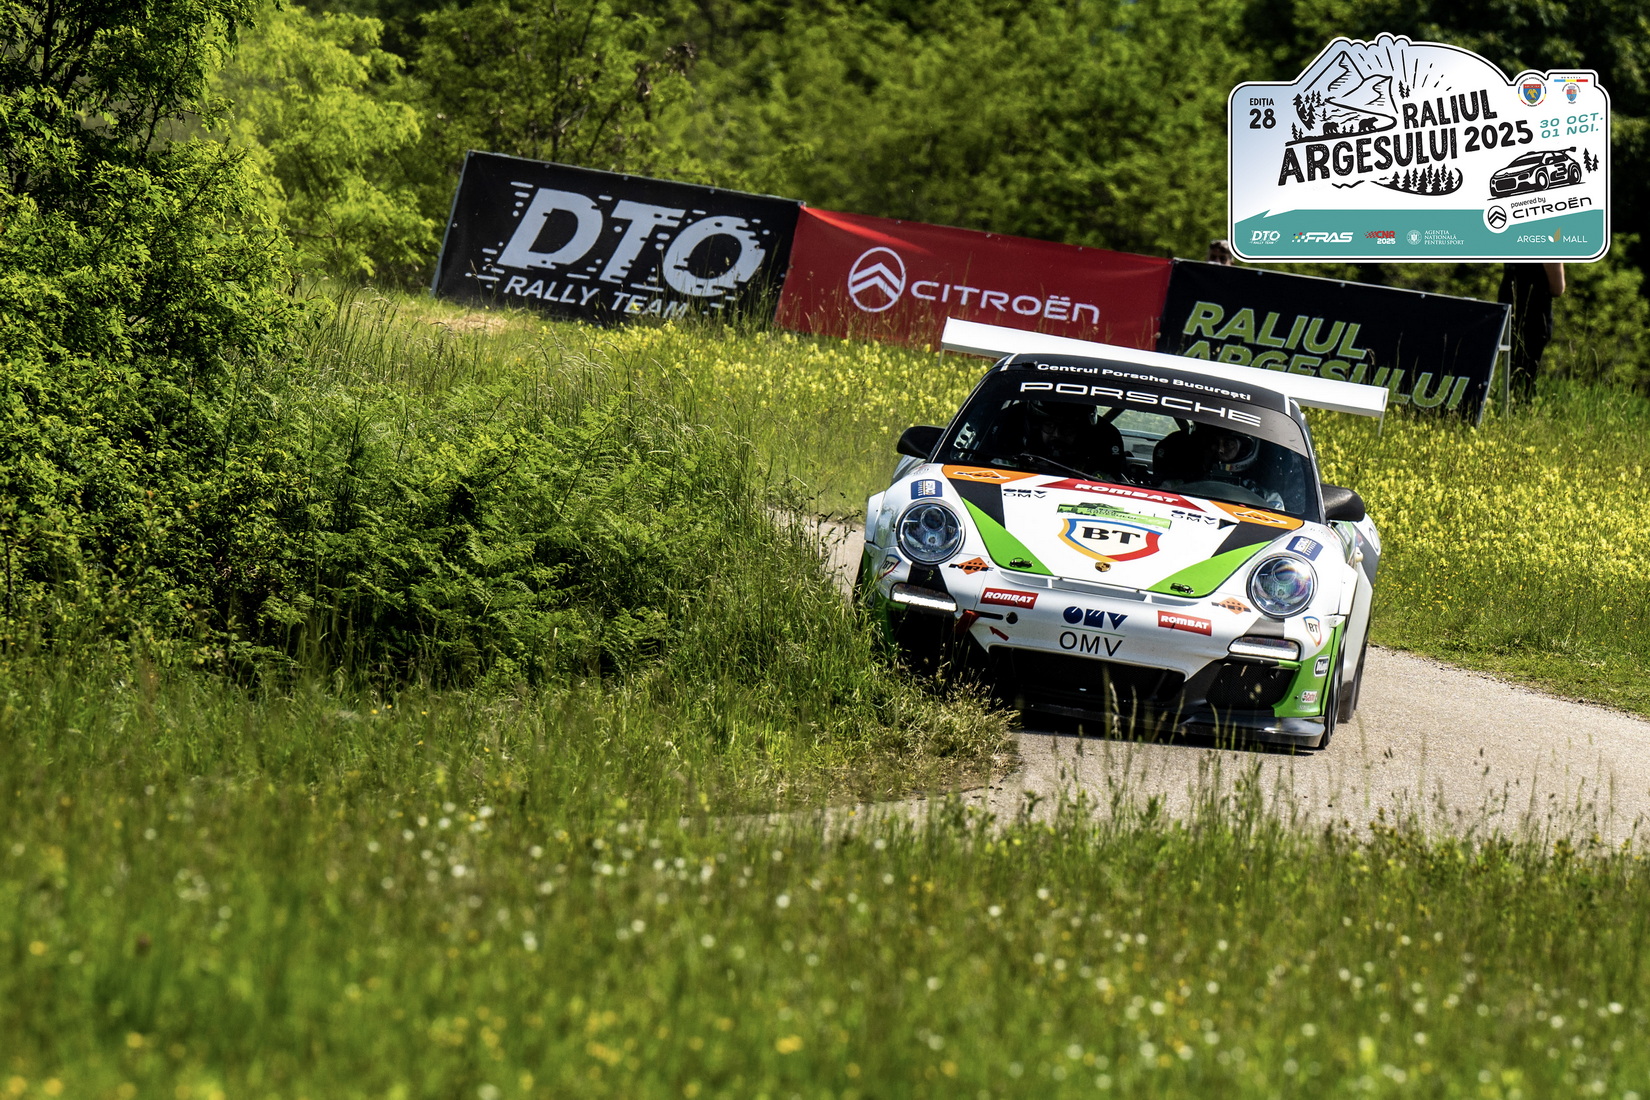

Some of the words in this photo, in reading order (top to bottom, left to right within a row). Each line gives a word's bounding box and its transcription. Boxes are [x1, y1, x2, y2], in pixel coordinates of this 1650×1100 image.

[497, 187, 766, 298] DTO
[504, 275, 599, 306] RALLY
[611, 291, 690, 318] TEAM
[1183, 301, 1367, 360] RALIUL
[1037, 363, 1098, 374] Centrul
[1102, 368, 1169, 384] Porsche
[1019, 381, 1262, 427] PORSCHE
[1074, 483, 1179, 503] ROMBAT
[1082, 526, 1141, 544] BT
[984, 591, 1034, 604] ROMBAT
[1160, 615, 1210, 630] ROMBAT
[1308, 622, 1318, 633] BT
[1059, 631, 1123, 657] OMV
